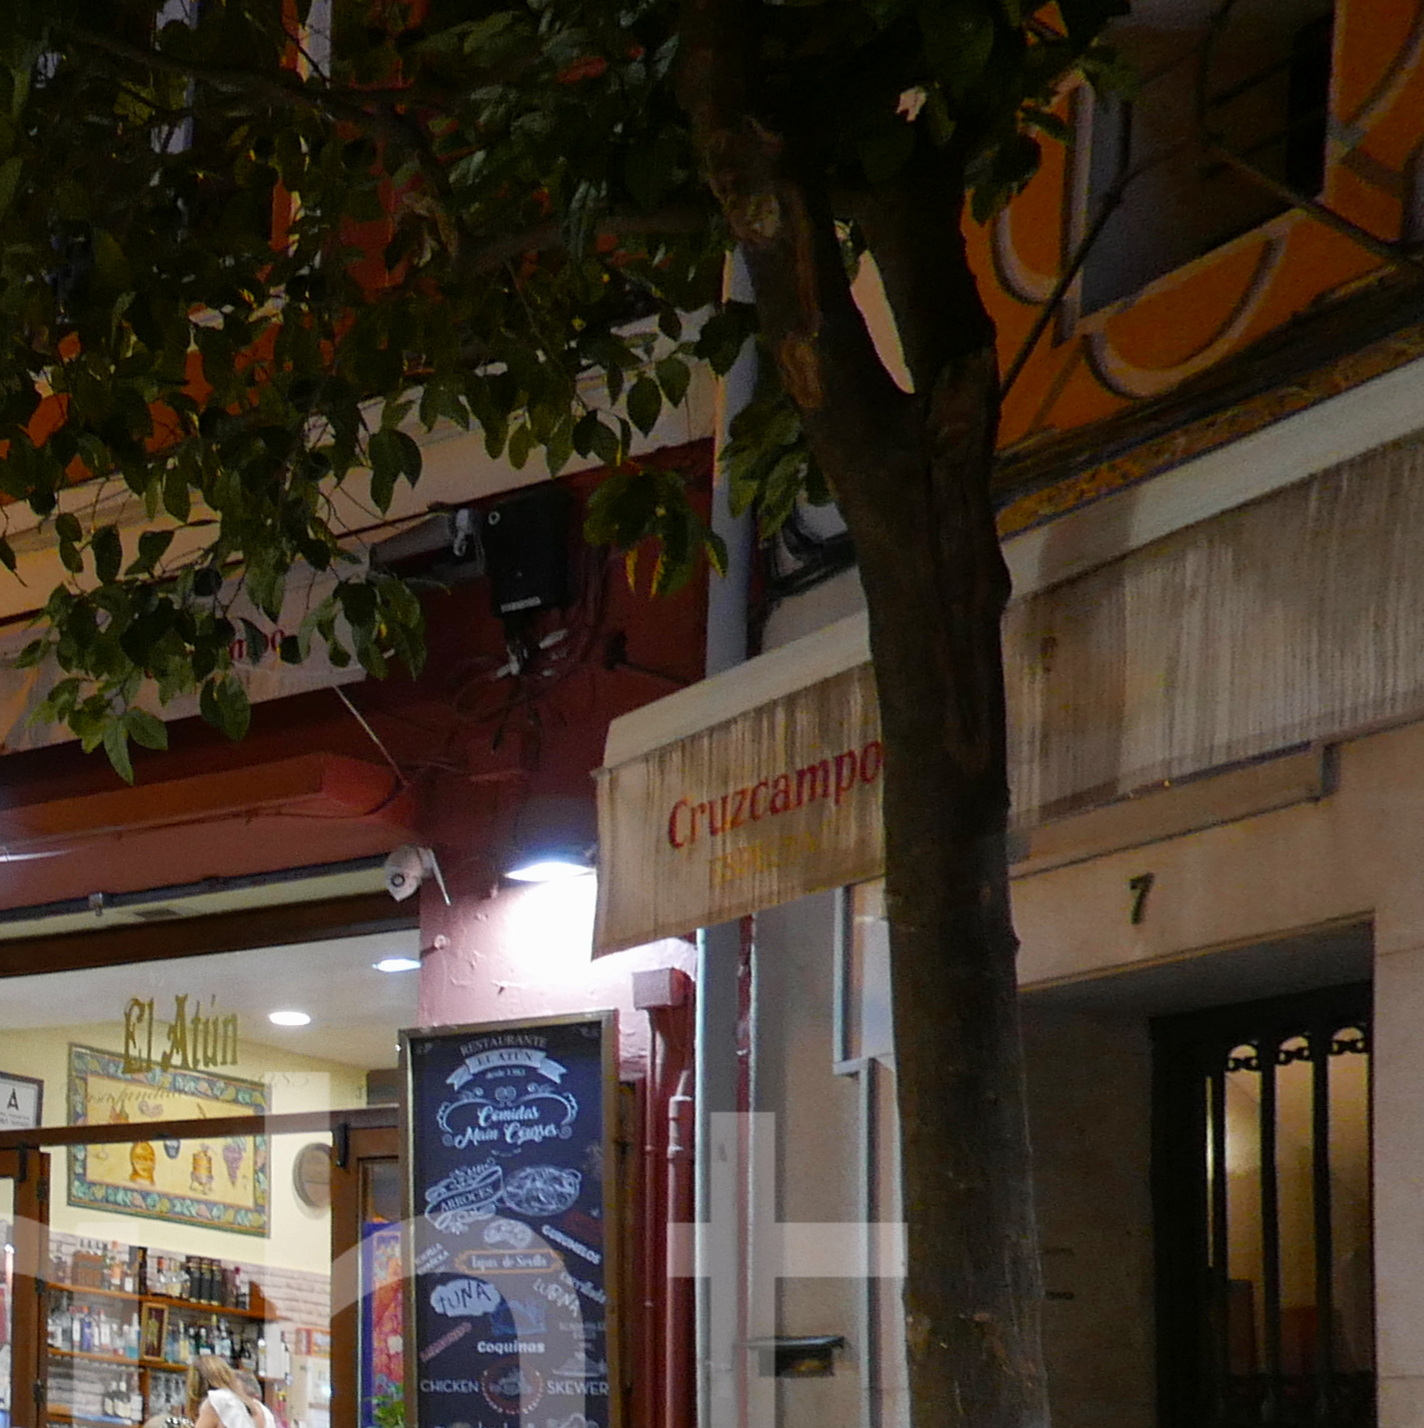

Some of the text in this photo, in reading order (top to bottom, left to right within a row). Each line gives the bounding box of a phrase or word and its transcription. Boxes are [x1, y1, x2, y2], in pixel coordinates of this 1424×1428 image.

[667, 741, 885, 849] Cruzcampo
[1128, 872, 1155, 926] 7
[121, 993, 239, 1075] El Atún
[459, 1034, 548, 1057] RESTAURANTE
[477, 1105, 540, 1127] Comidas
[454, 1126, 499, 1149] Main
[420, 1379, 610, 1396] CHICKEN SKEWER
